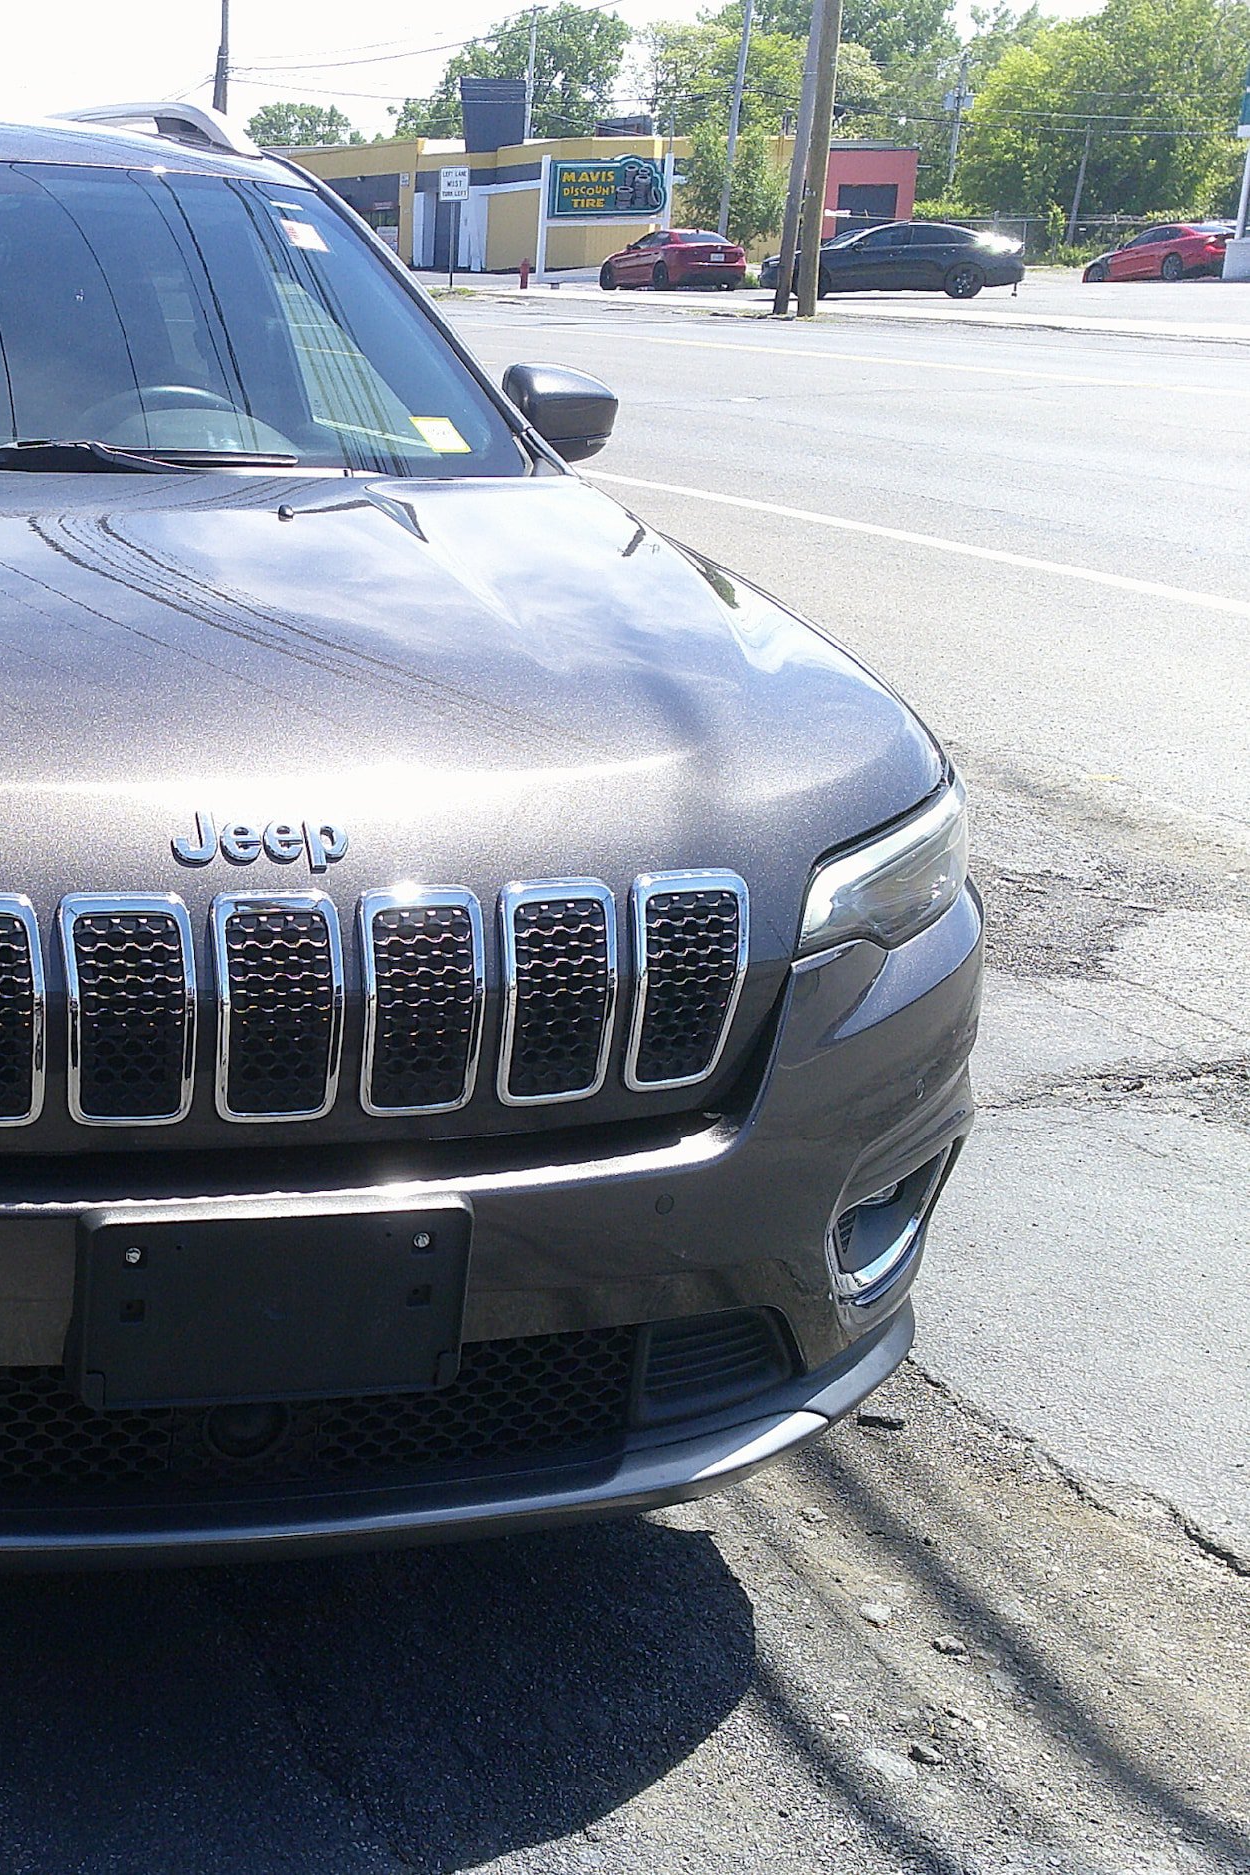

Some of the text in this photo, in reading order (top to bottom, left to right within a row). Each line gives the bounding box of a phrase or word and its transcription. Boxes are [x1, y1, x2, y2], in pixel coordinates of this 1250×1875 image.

[562, 171, 615, 183] MAVIS
[563, 185, 616, 196] DISCOUNT
[571, 198, 606, 208] TIRE
[171, 810, 349, 874] Jeep
